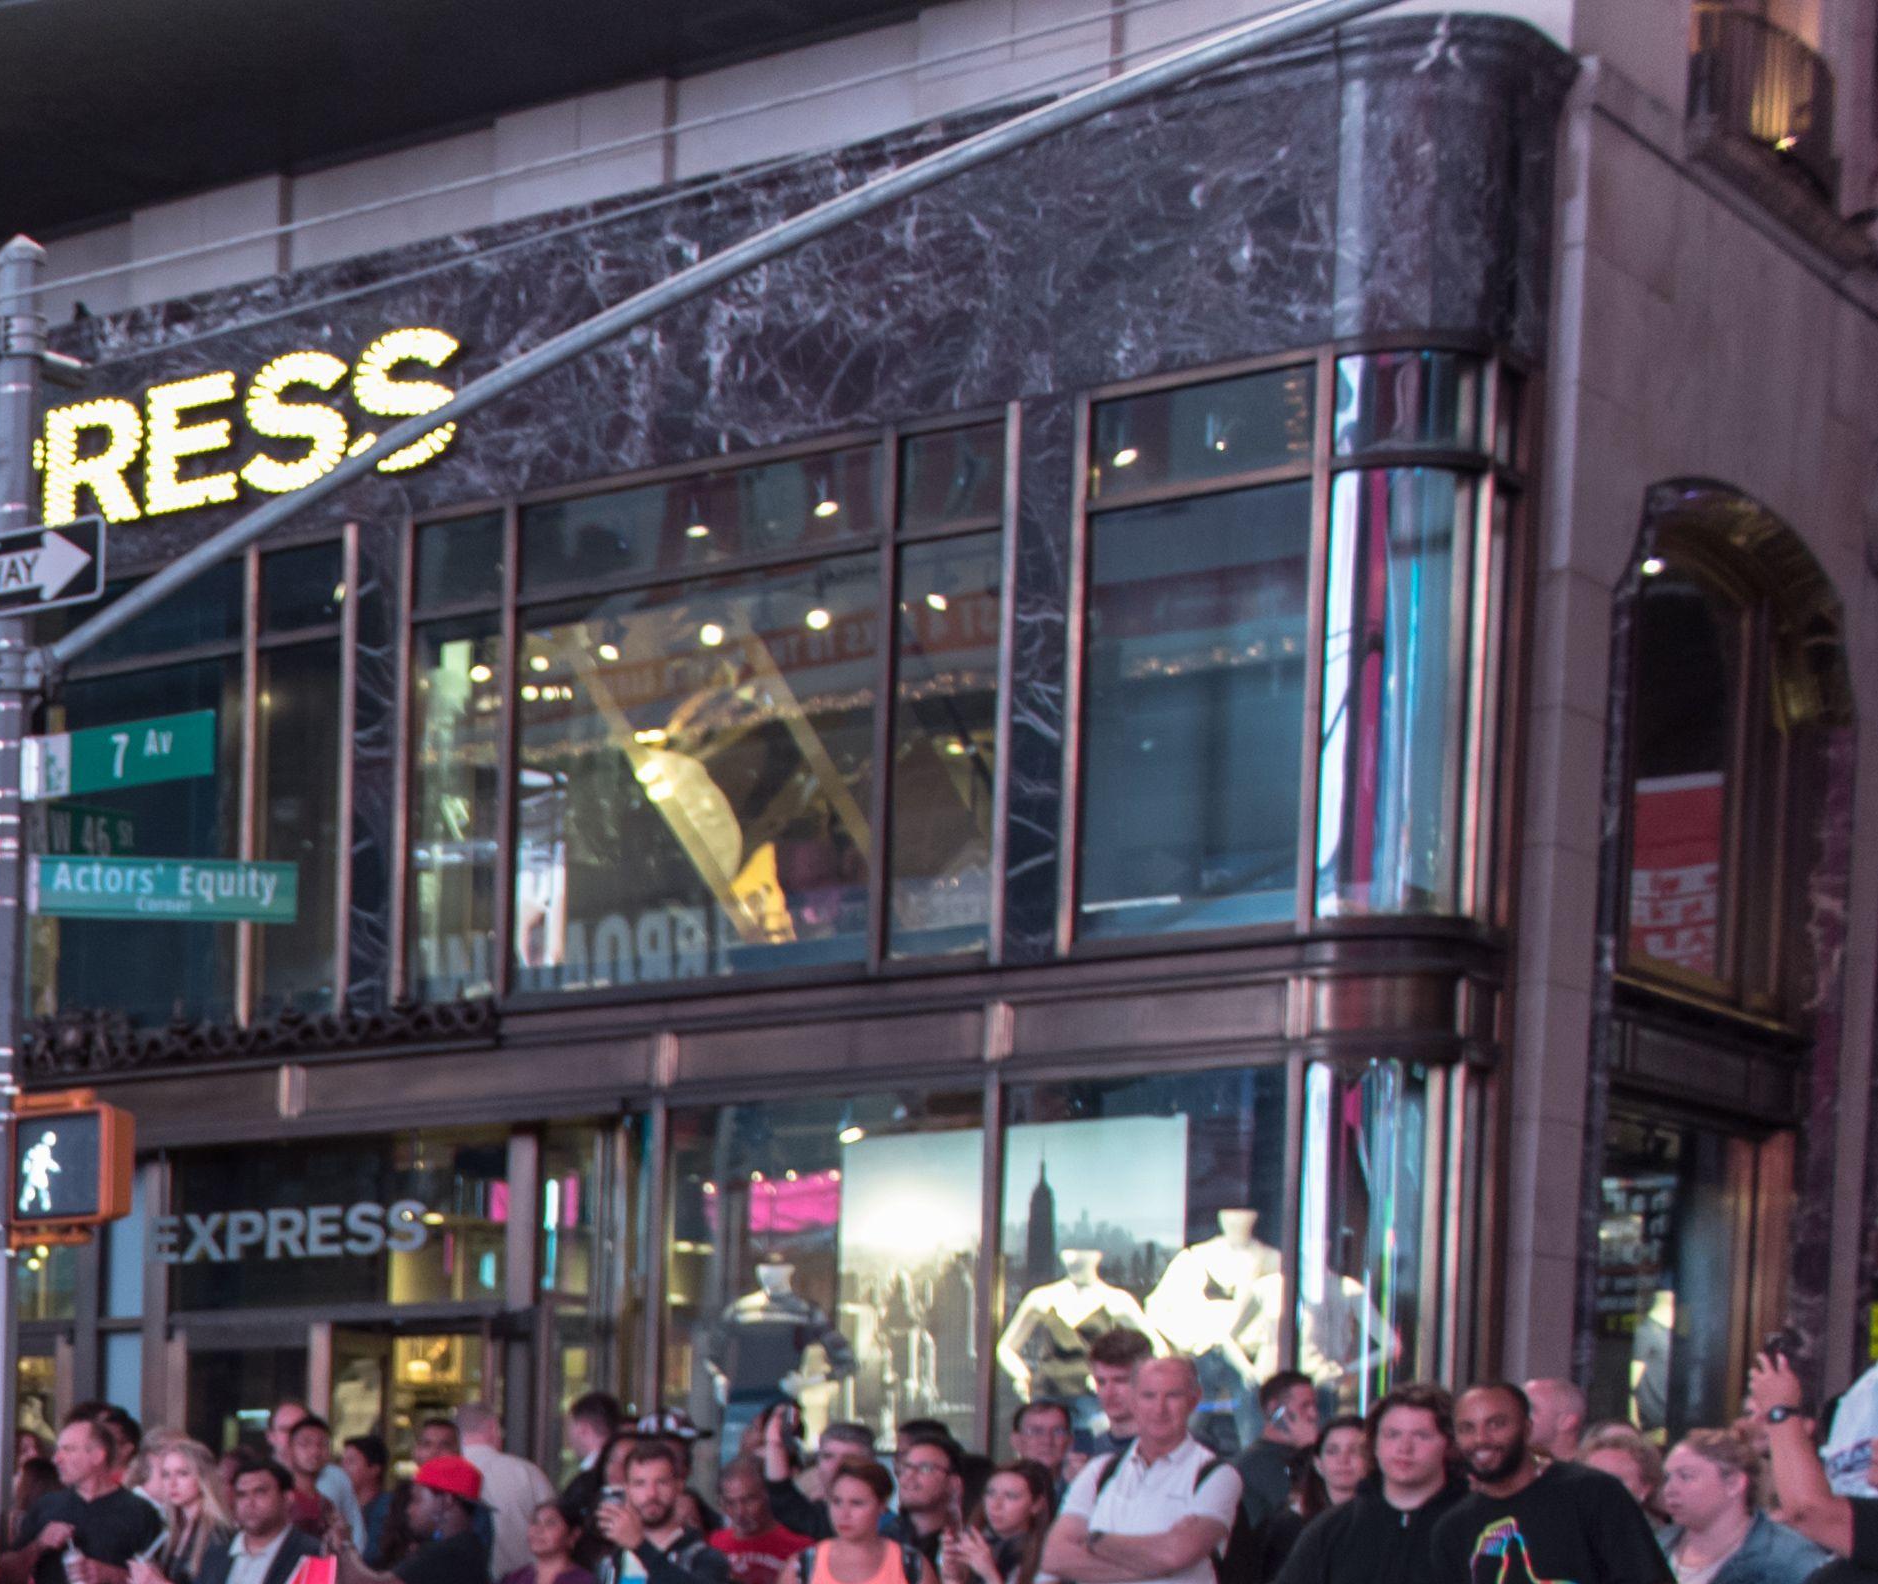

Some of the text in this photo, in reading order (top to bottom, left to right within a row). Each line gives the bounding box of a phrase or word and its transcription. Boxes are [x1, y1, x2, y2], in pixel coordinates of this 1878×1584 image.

[111, 732, 130, 779] 7
[51, 861, 279, 908] Actors' Equity
[153, 1199, 430, 1265] EXPRESS
